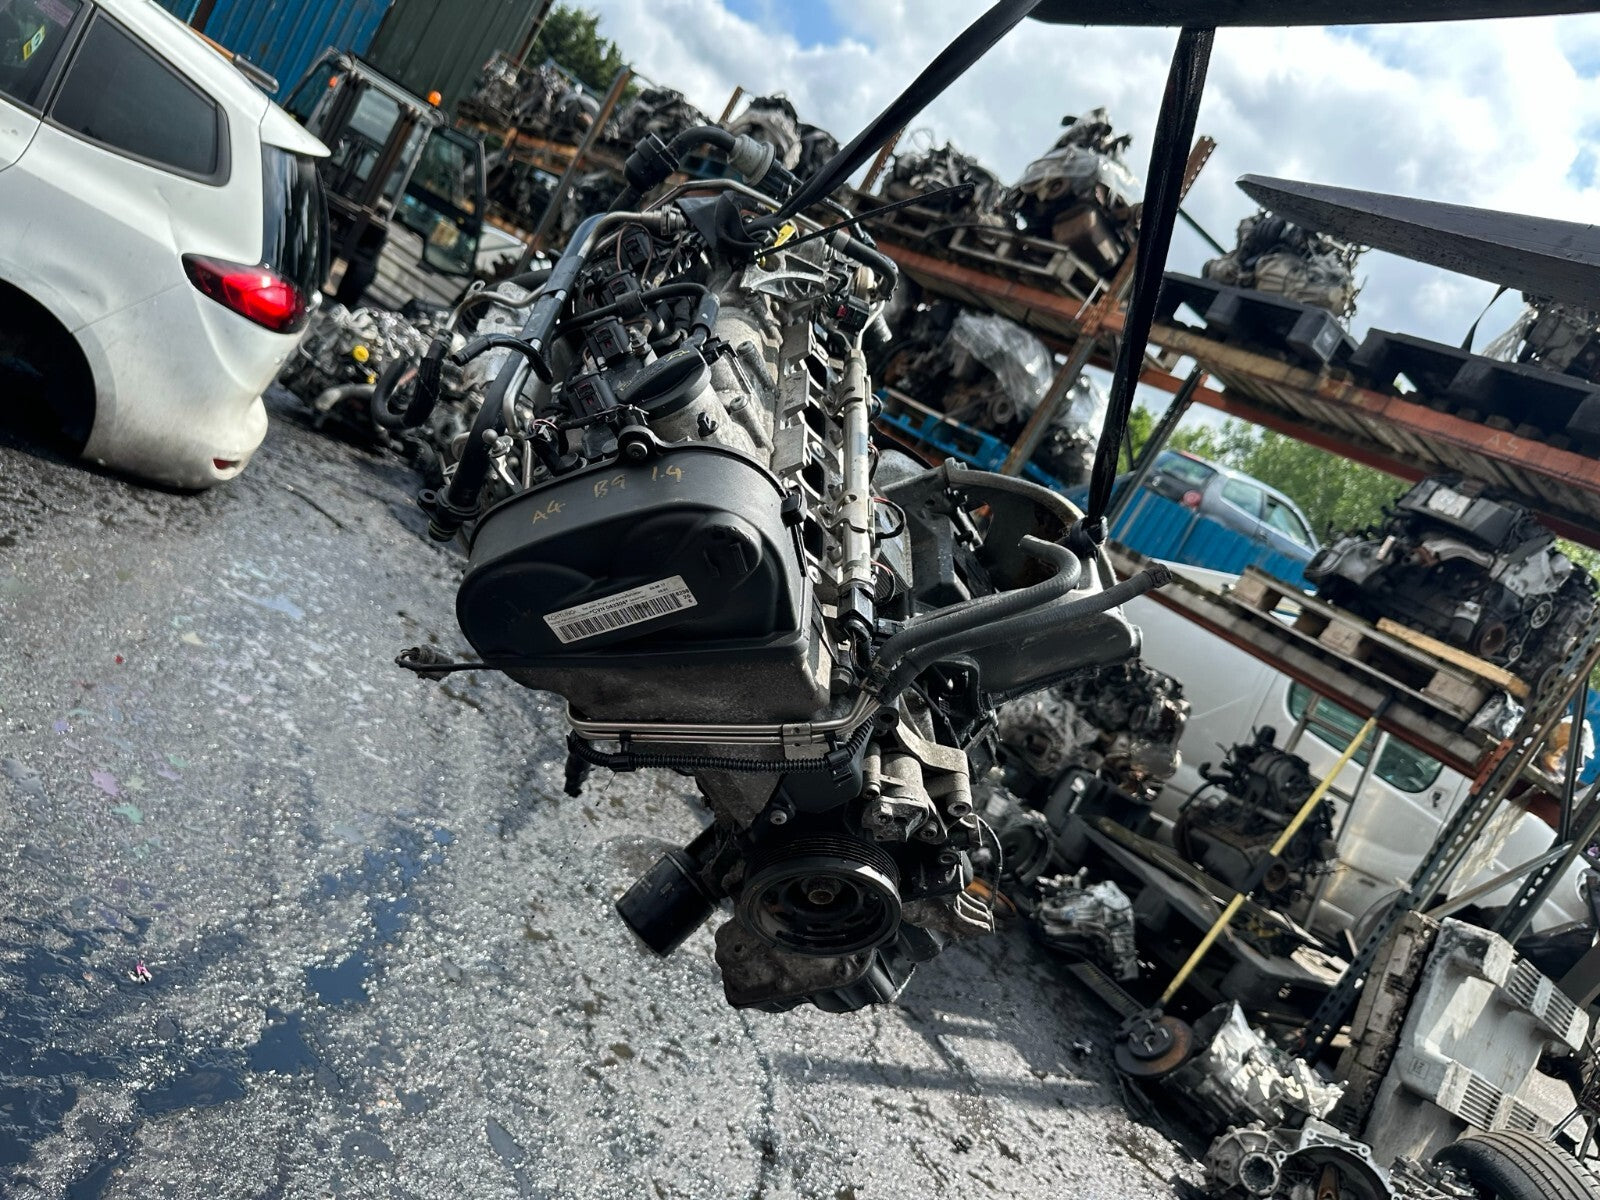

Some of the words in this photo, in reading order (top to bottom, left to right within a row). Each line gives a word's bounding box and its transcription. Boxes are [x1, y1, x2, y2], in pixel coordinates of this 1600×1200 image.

[532, 500, 566, 524] A4
[593, 473, 627, 498] B9
[652, 464, 685, 483] 1.4
